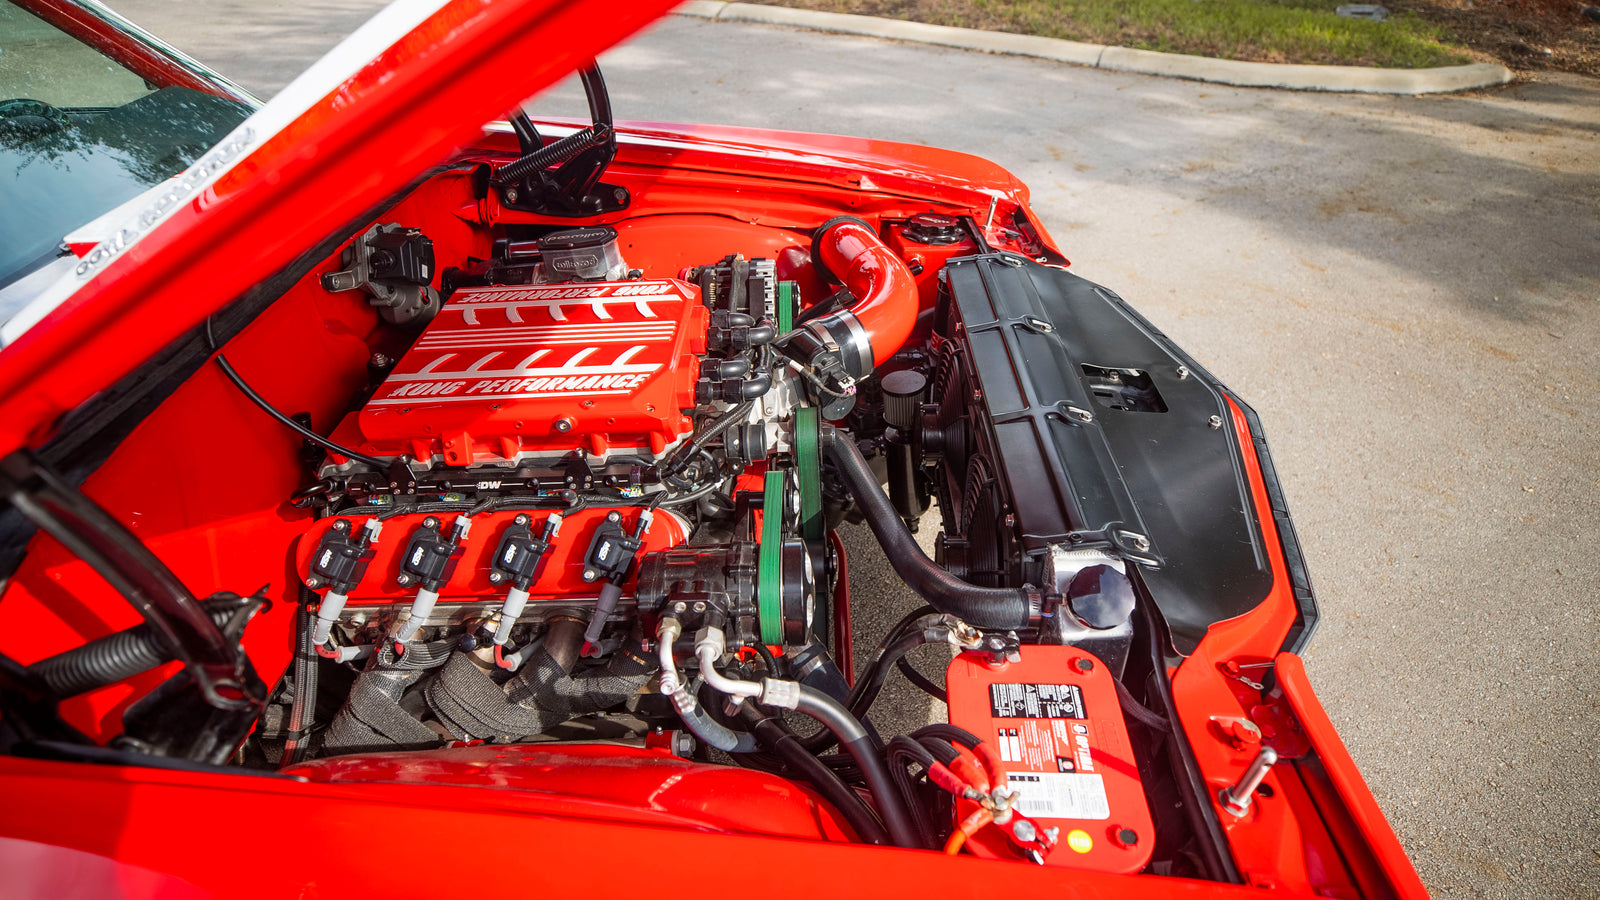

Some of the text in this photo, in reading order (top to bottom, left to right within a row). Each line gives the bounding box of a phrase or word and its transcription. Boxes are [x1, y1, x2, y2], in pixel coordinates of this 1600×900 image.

[457, 284, 674, 302] KONG PERFORMANCE
[387, 374, 650, 398] KONG PERFORMANCE
[478, 481, 502, 490] DW
[1075, 735, 1094, 772] OPTIMA
